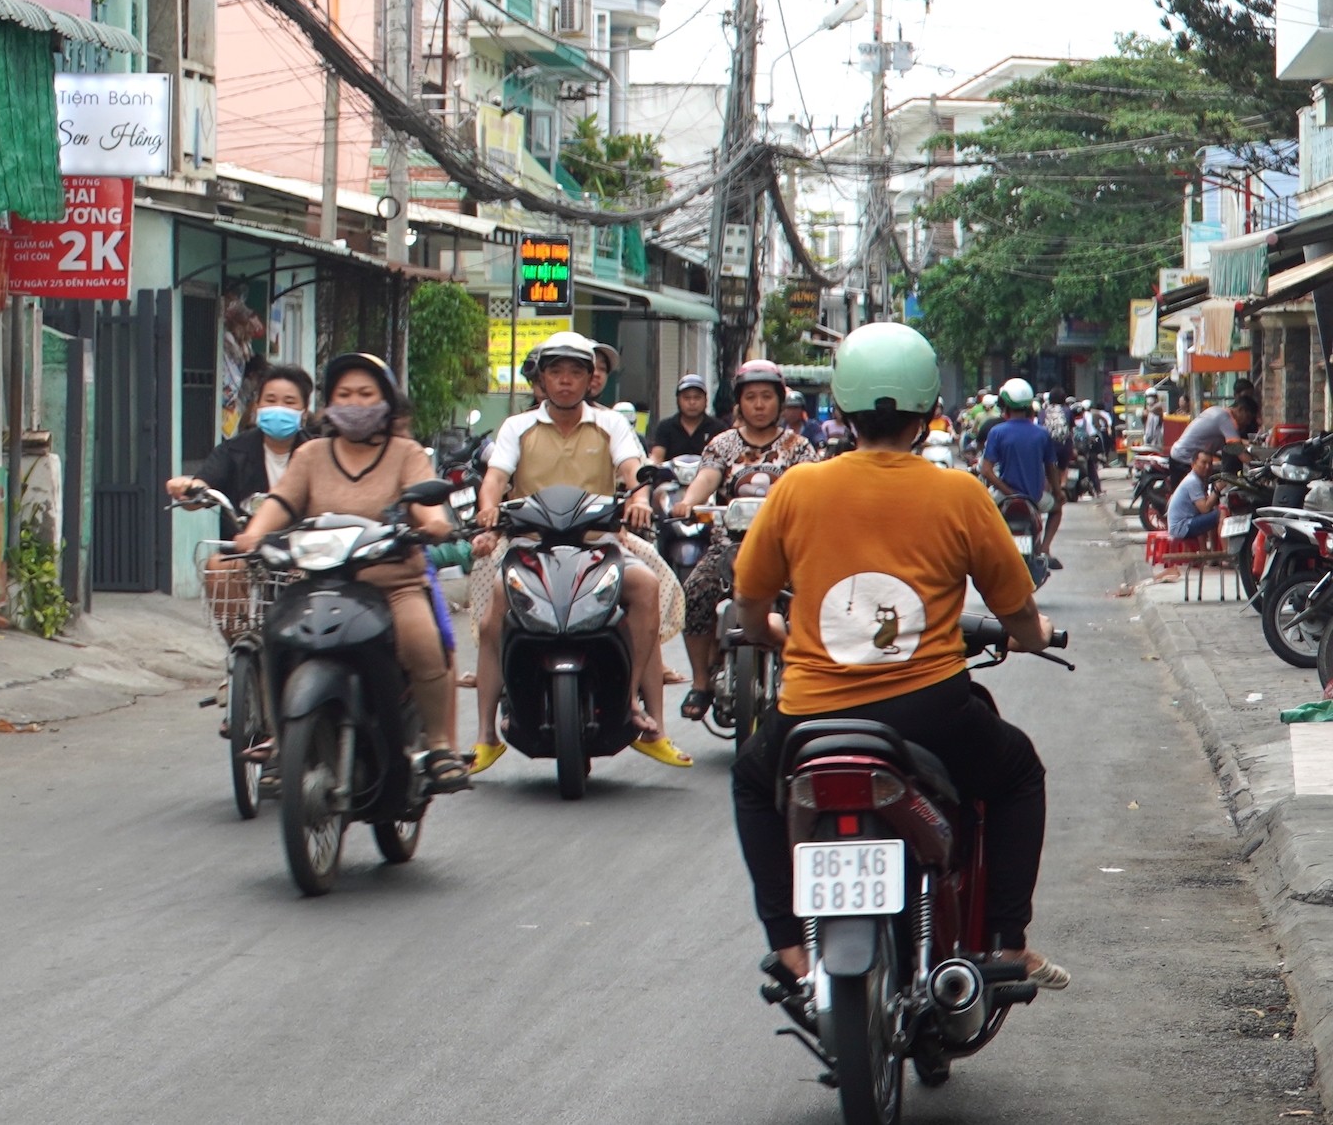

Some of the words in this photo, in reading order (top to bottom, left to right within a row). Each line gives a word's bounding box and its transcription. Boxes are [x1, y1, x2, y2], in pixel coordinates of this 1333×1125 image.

[58, 89, 100, 106] Tiệm
[109, 88, 154, 106] Bánh
[58, 119, 90, 148] Sen
[99, 122, 165, 155] Hồng
[57, 230, 126, 272] 2K
[811, 848, 887, 879] 86-K6
[811, 881, 886, 910] 6838
